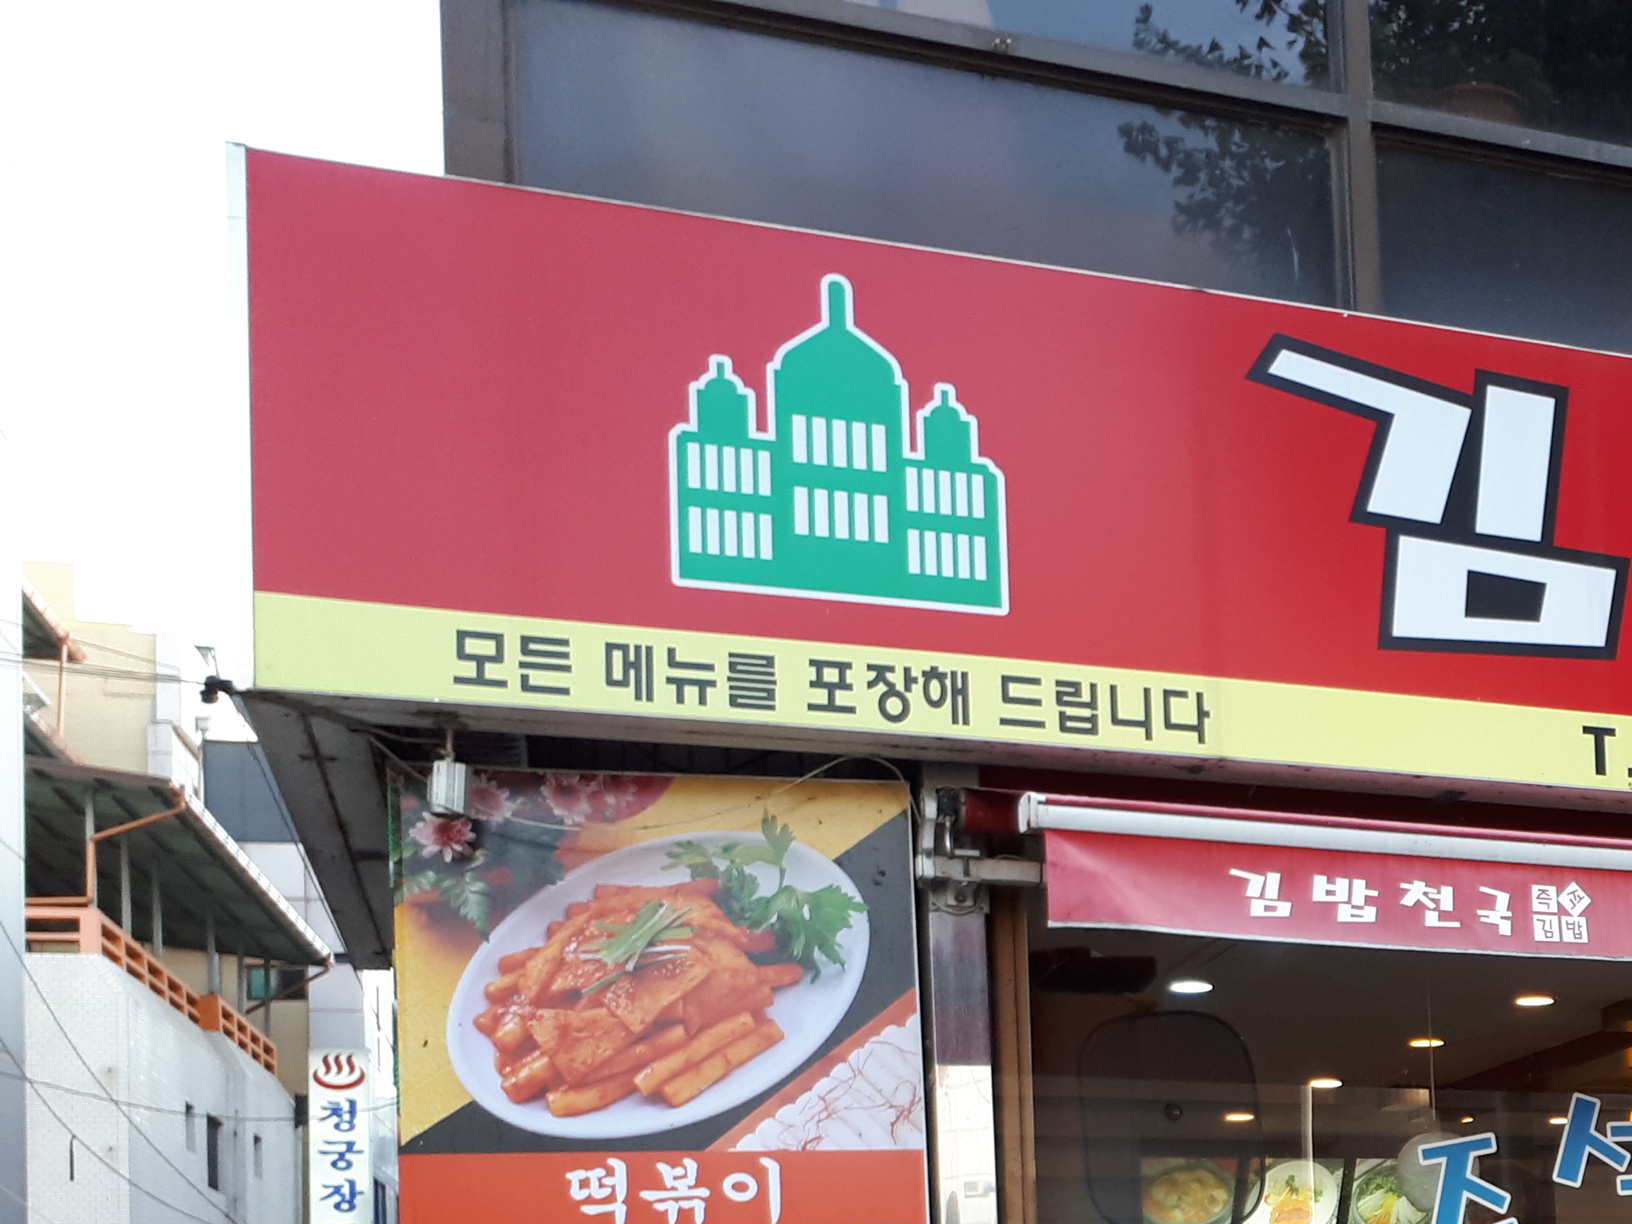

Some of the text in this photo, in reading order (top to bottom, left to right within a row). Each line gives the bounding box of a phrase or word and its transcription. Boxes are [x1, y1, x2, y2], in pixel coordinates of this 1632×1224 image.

[452, 628, 1211, 746] 모든 메뉴를 포장해 드립니다
